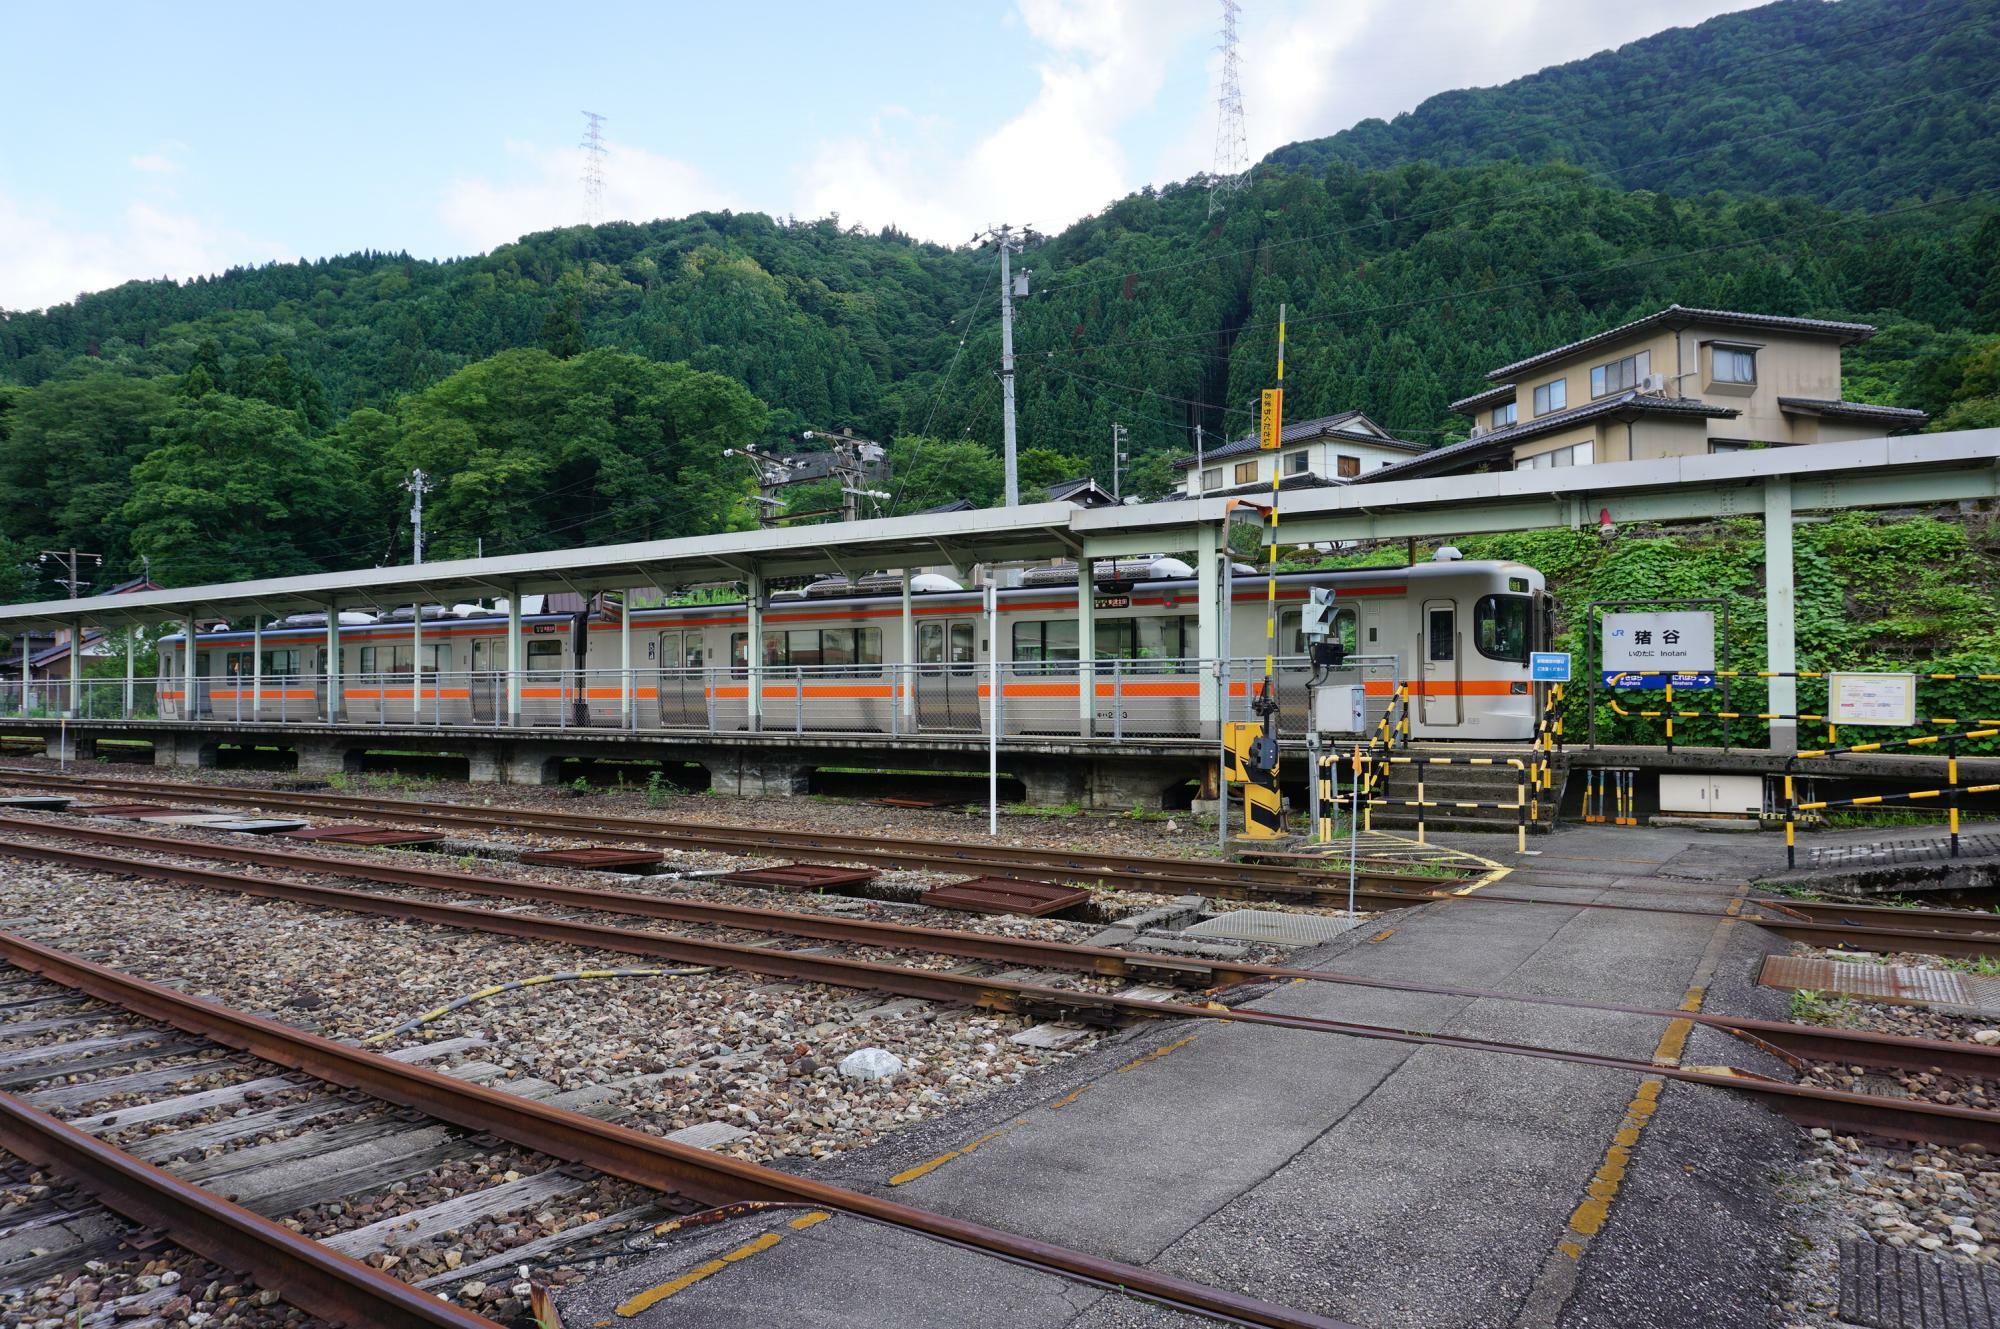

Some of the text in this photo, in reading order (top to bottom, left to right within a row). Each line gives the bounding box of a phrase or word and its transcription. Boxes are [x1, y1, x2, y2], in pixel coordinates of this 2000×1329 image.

[1263, 392, 1272, 447] おまちください
[1612, 629, 1624, 637] JR
[1634, 630, 1680, 645] 猪谷
